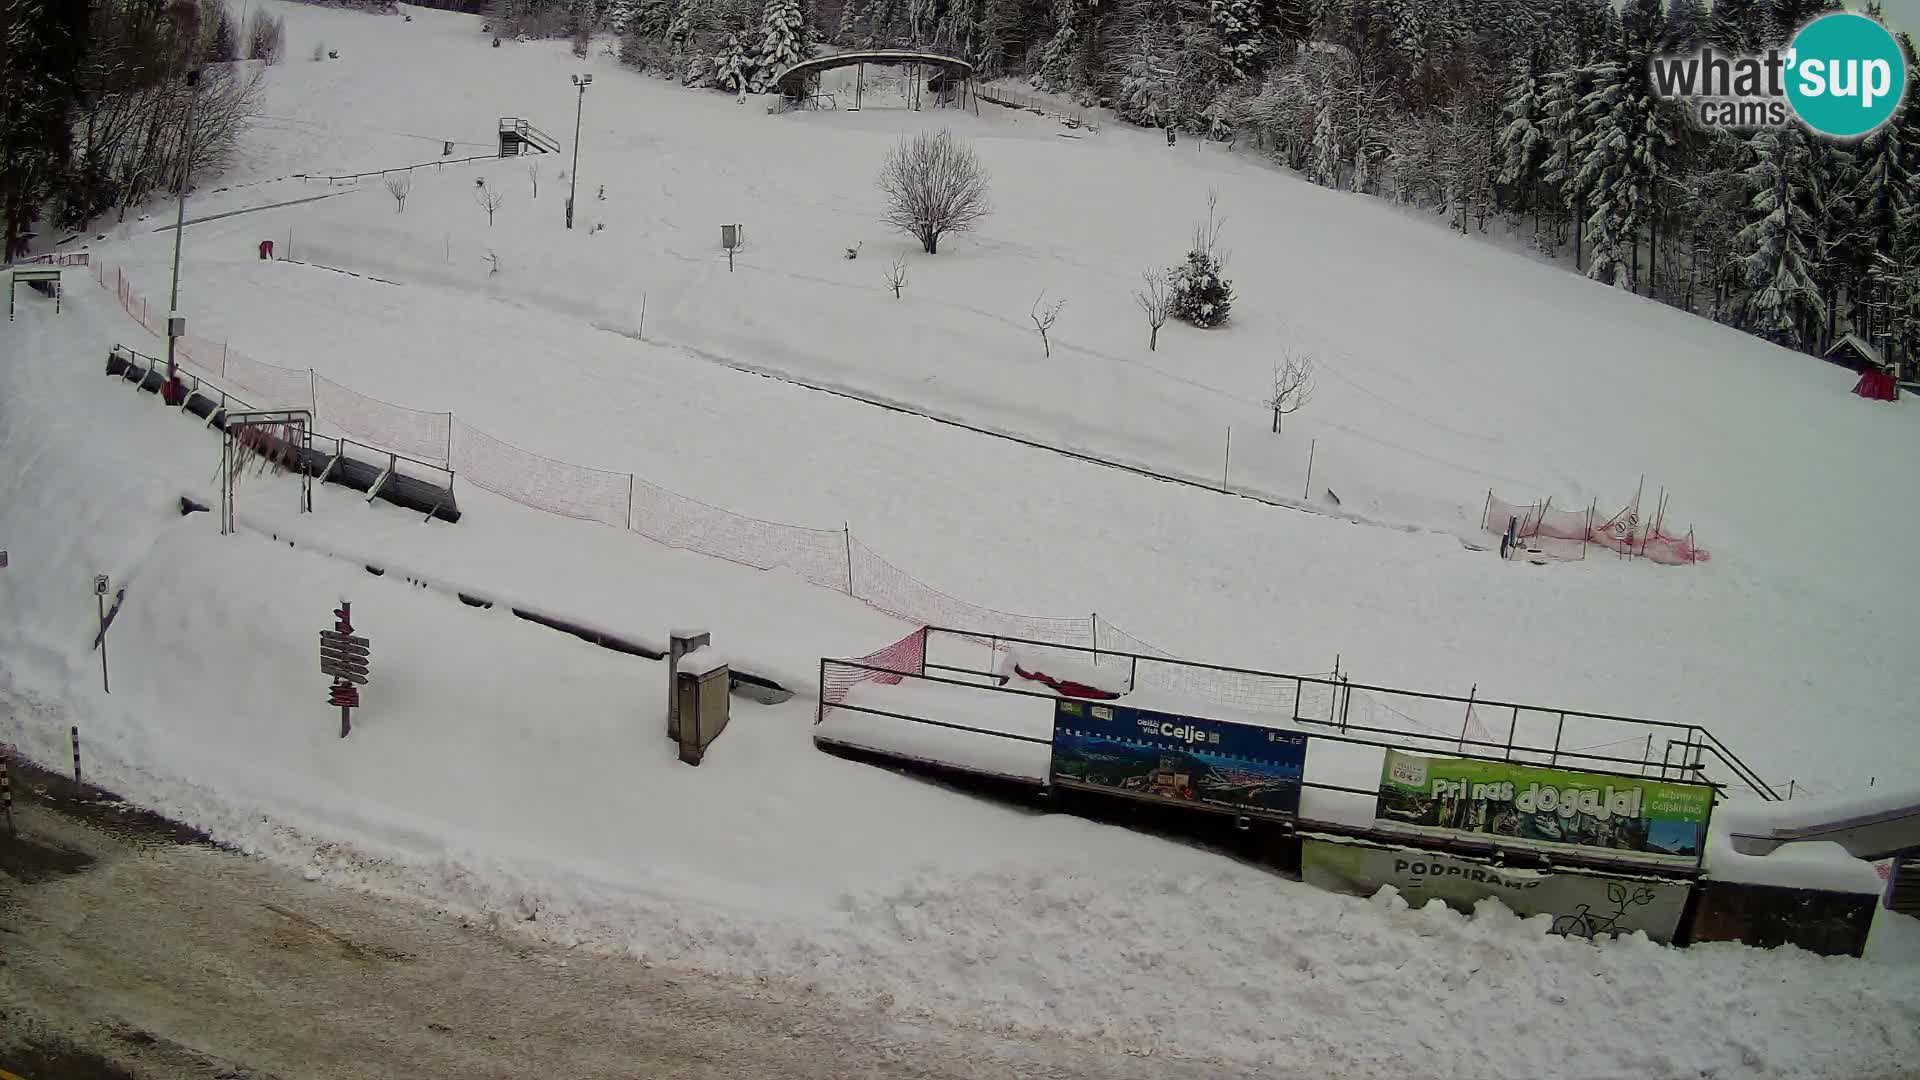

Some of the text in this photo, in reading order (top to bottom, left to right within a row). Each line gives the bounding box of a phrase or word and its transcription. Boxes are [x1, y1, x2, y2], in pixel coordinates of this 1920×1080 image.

[1160, 722, 1206, 744] Celje
[1472, 781, 1515, 802] nas
[1515, 782, 1643, 821] dogaja!
